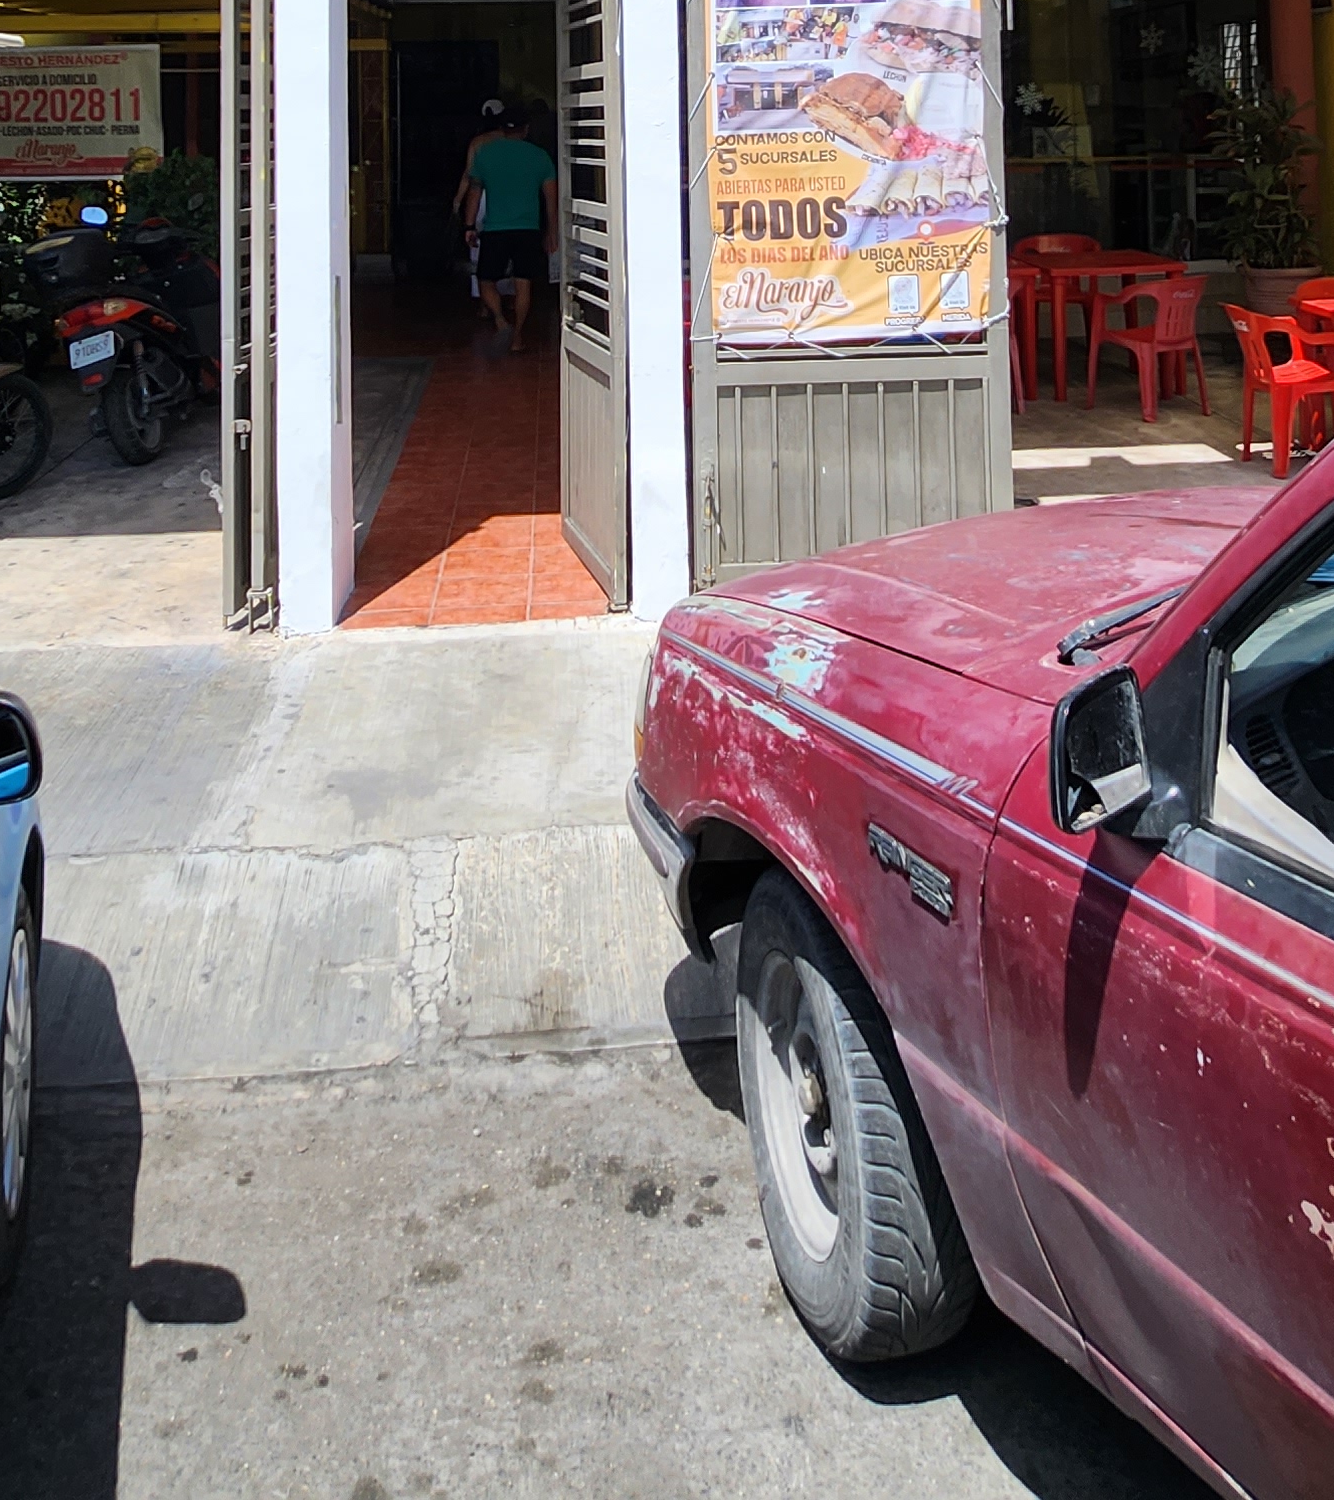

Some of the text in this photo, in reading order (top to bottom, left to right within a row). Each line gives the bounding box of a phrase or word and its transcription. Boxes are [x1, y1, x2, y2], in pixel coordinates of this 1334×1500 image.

[41, 74, 48, 86] A
[49, 73, 97, 86] DOMICILIO
[110, 124, 140, 136] PIERNA
[715, 131, 836, 146] CONTAMOS CON
[717, 147, 838, 175] 5 SUCURSALES
[716, 175, 846, 195] ABIERTAS PARA USTED
[717, 196, 848, 240] TODOS
[720, 241, 850, 265] LOS DIAS DEL AÑO
[859, 242, 989, 260] UBICA NUESTRAS
[875, 256, 972, 273] SUCURSALES
[722, 271, 848, 321] El Naranjo
